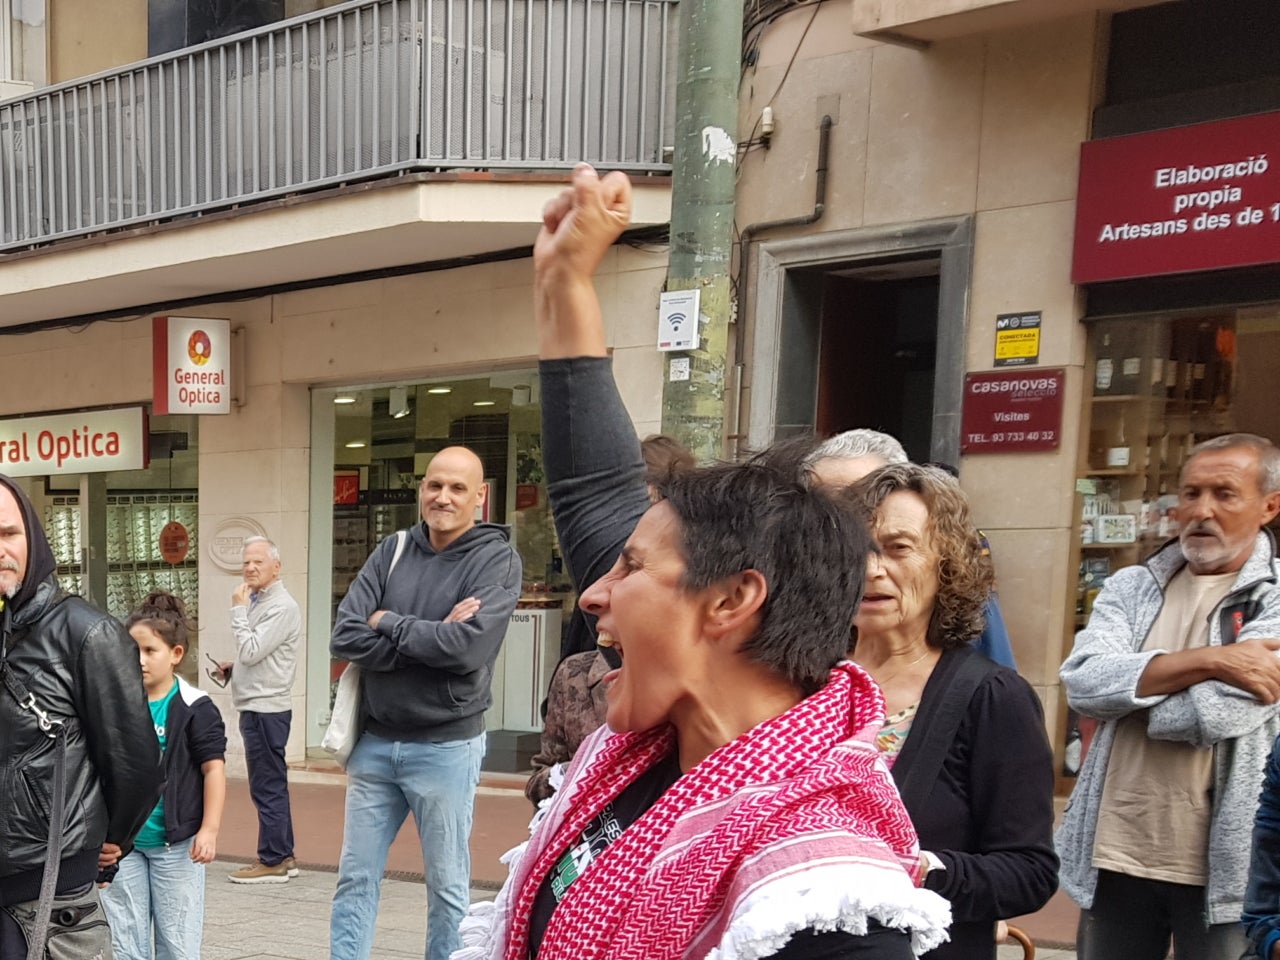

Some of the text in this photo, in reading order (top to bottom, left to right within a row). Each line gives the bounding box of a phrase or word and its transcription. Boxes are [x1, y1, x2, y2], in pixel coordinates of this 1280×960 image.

[1155, 154, 1269, 188] Elaboració
[1174, 184, 1242, 214] propia
[1099, 218, 1188, 243] Artesans
[1193, 212, 1231, 232] des
[1237, 206, 1264, 226] de
[174, 368, 226, 385] General
[971, 378, 1057, 393] casanovas
[178, 387, 221, 406] Optica
[994, 411, 1030, 422] Visites
[992, 432, 1004, 442] 93
[1007, 431, 1024, 441] 733
[1026, 431, 1039, 441] 40
[1041, 431, 1054, 440] 32
[36, 425, 121, 468] Optica
[511, 614, 529, 623] TOUS
